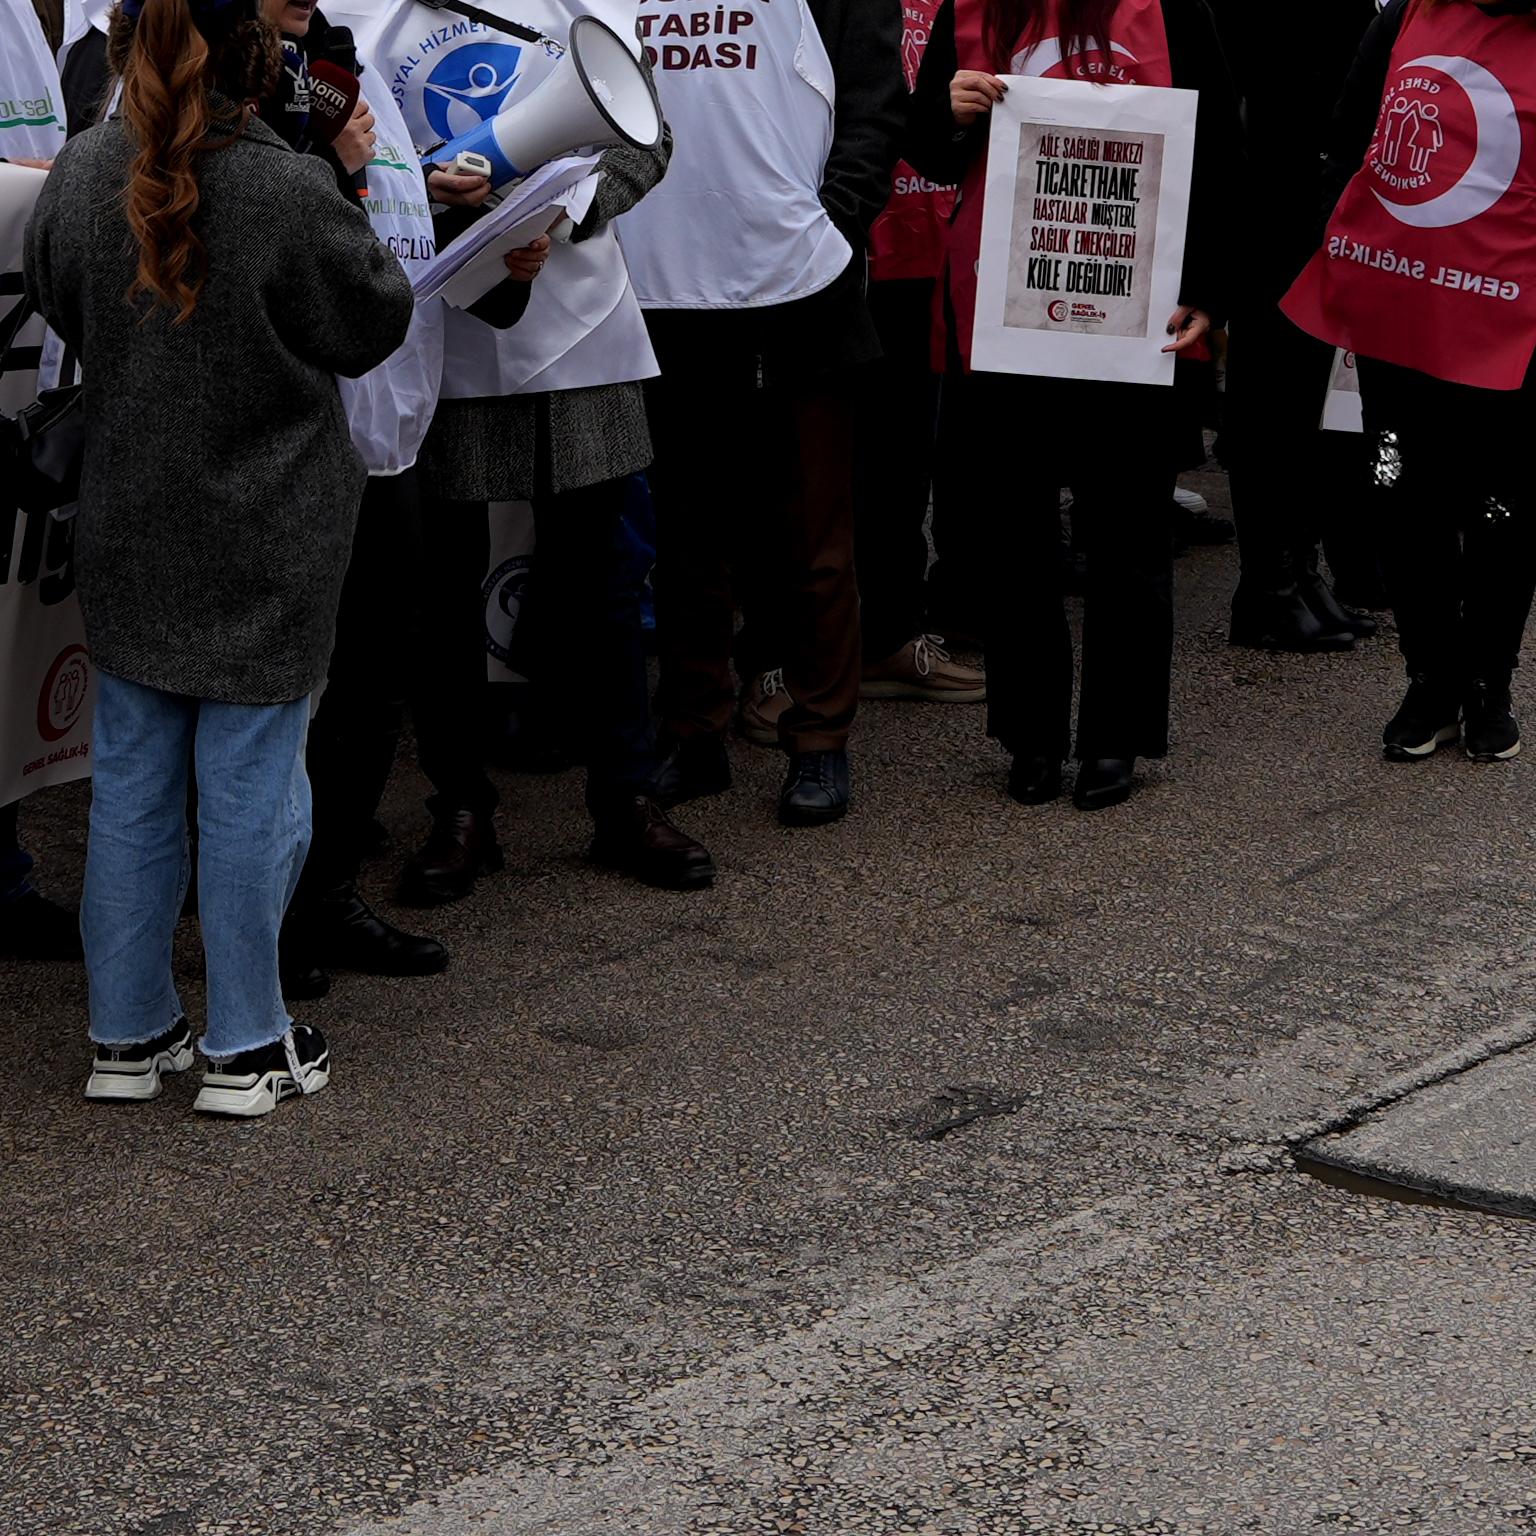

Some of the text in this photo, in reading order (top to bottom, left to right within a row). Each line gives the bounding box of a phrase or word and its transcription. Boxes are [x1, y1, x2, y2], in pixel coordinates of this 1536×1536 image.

[638, 4, 754, 38] TABİP
[1039, 133, 1145, 165] AİLE SAĞLIĞI MERKEZİ
[1036, 157, 1141, 204] TİCARETHANE,
[1033, 197, 1088, 224] HASTALAR
[1030, 224, 1137, 261] SAĞLIK EMEKÇİLERİ
[1026, 254, 1133, 297] KÖLE DEĞİLDİR!
